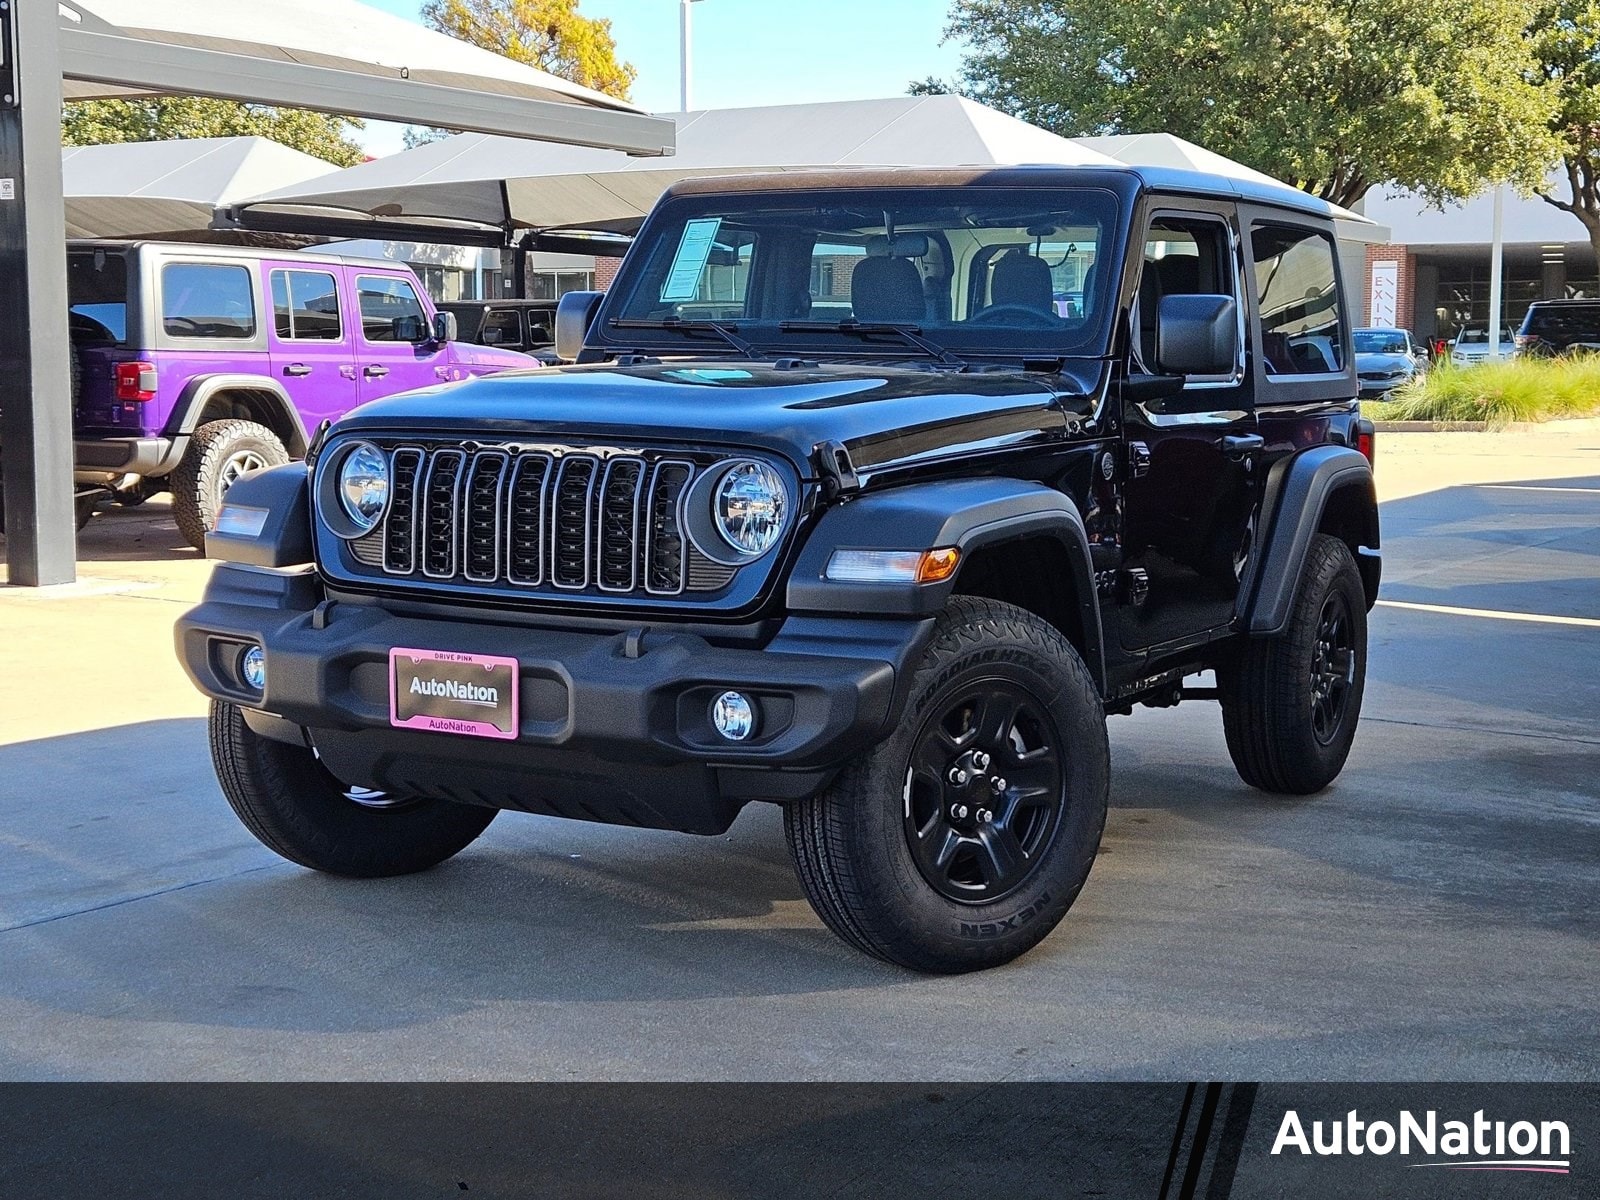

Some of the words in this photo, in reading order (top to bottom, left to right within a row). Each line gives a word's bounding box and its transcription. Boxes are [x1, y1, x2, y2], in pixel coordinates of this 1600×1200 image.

[1373, 276, 1383, 327] EXIT
[434, 652, 455, 661] DRIVE
[456, 654, 473, 662] PINK
[410, 676, 499, 701] AutoNation
[429, 719, 477, 733] AutoNation
[960, 890, 1051, 937] NEXEN
